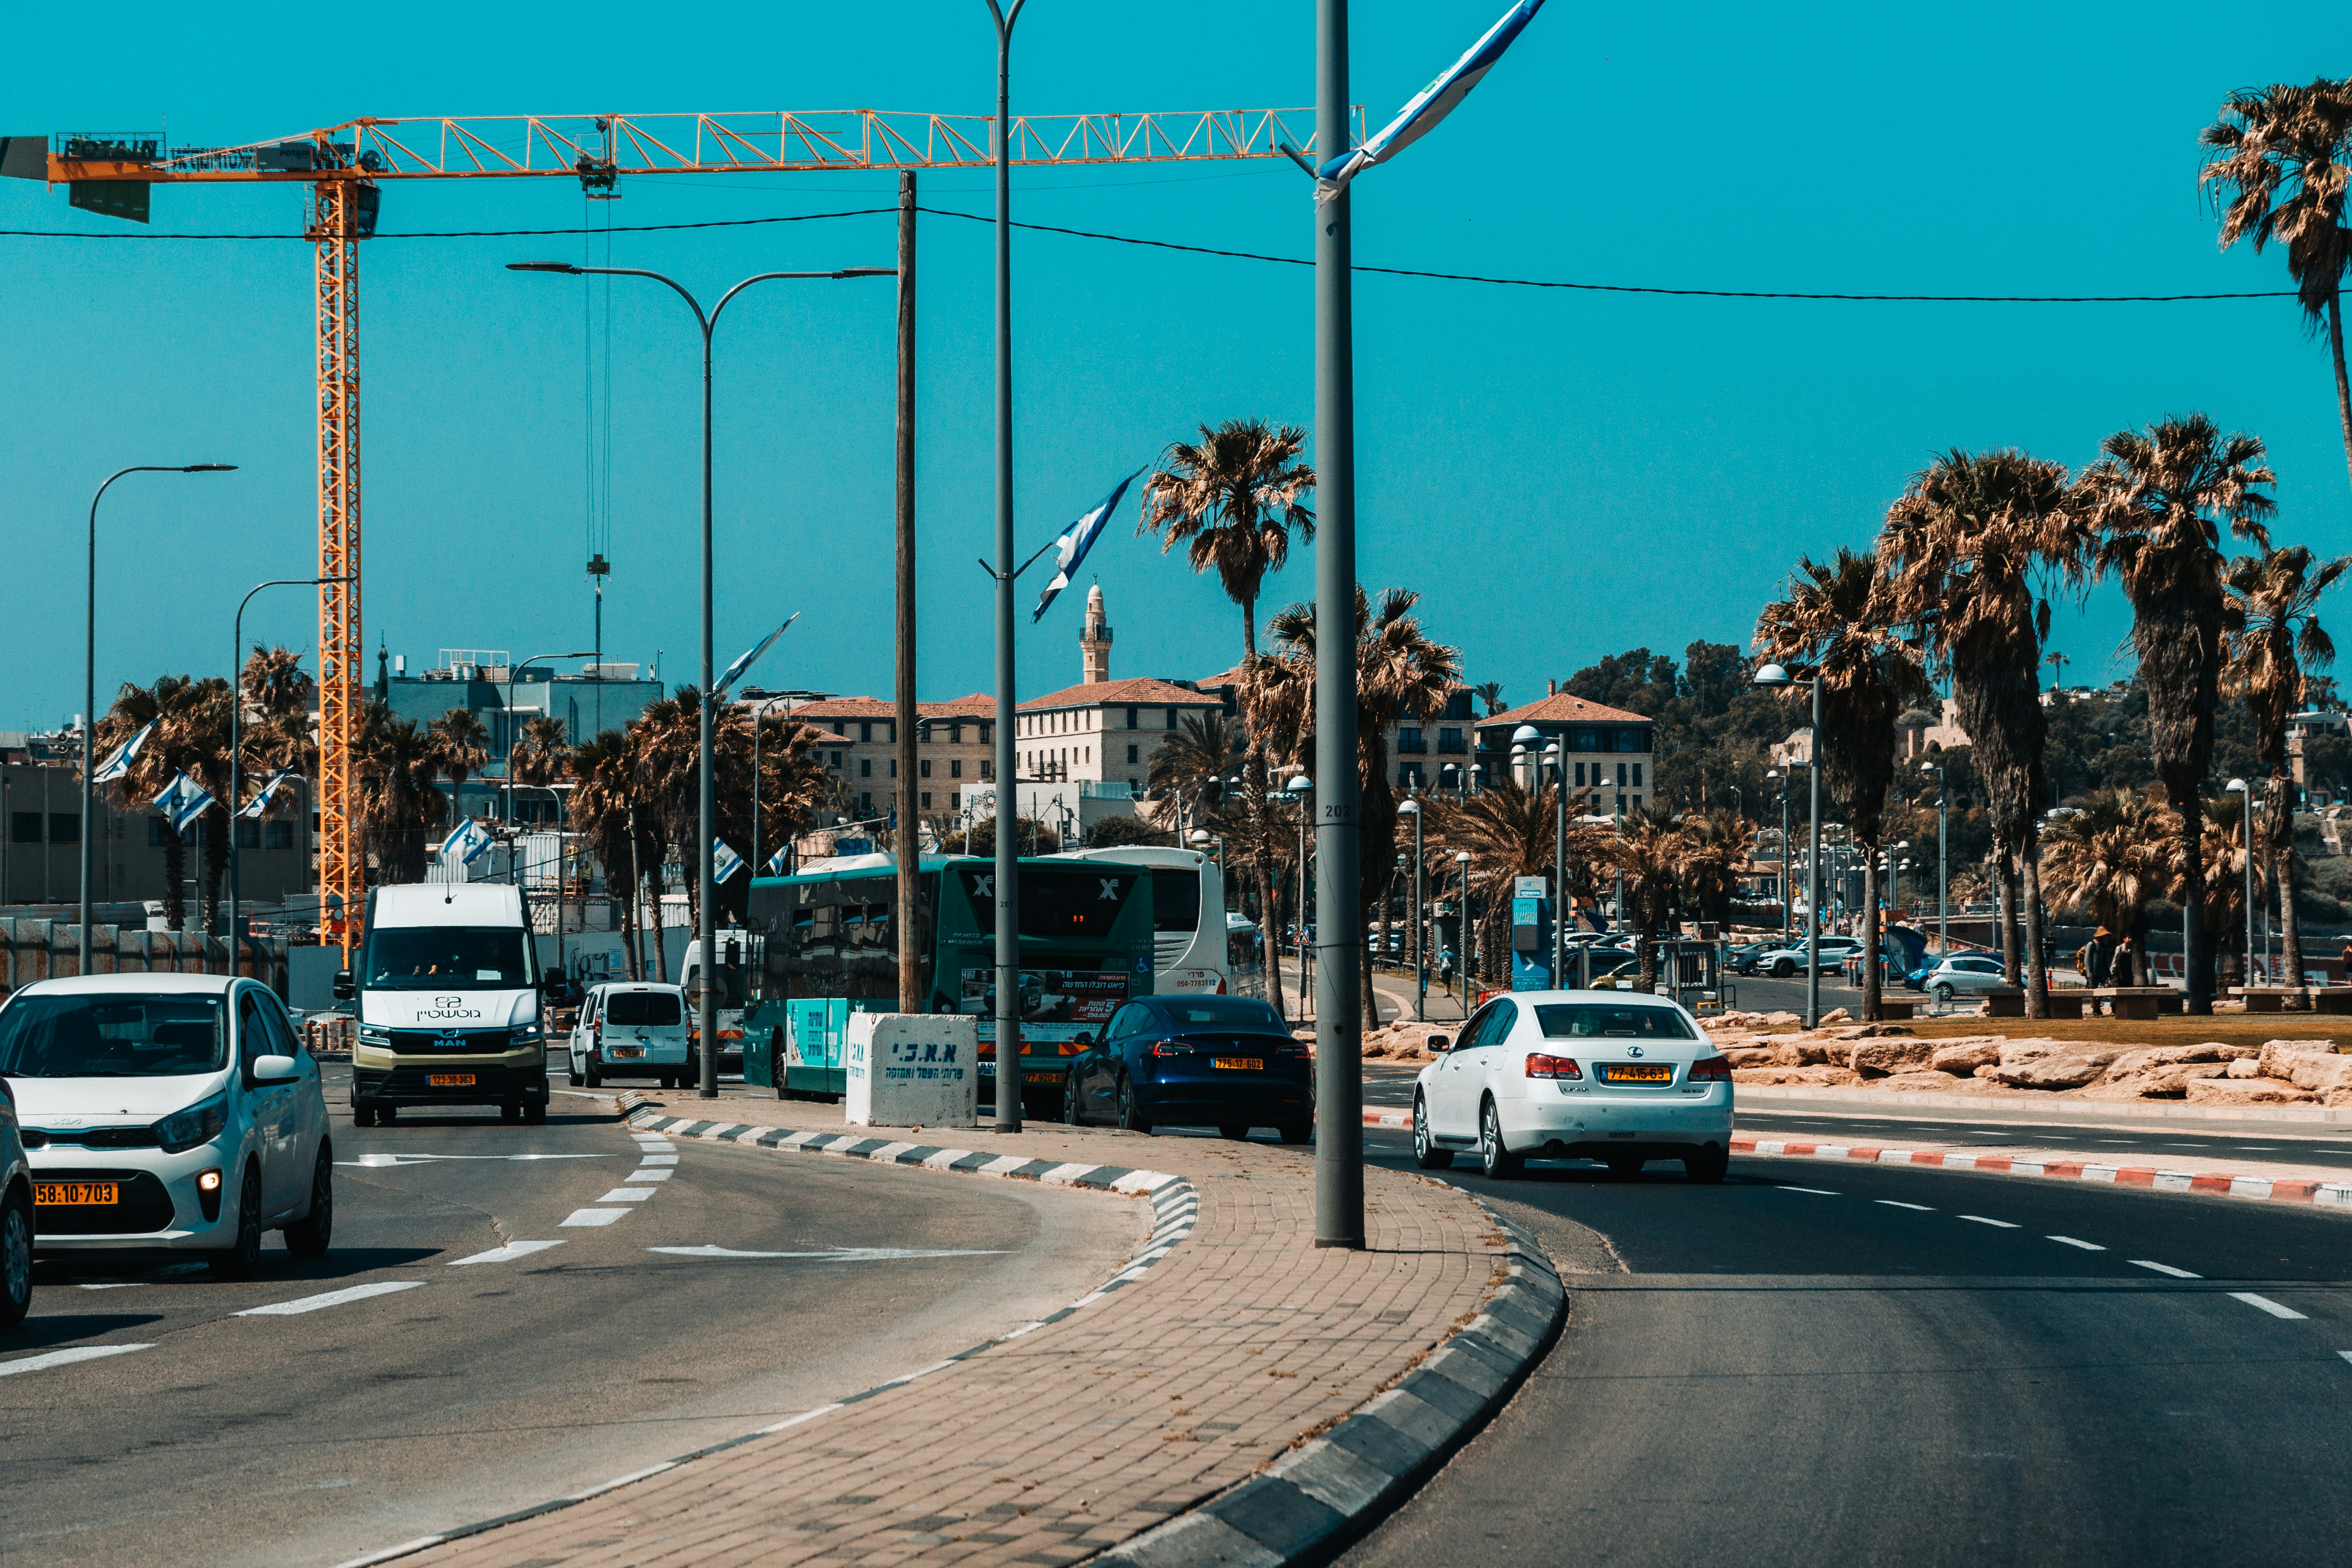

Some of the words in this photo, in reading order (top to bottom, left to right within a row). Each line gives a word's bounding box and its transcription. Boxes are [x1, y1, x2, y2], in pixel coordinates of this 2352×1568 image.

[64, 140, 158, 158] POTAIN
[1325, 805, 1351, 817] 202
[964, 970, 975, 979] FIAT
[1105, 1001, 1115, 1012] 5
[417, 1010, 480, 1021] גוטשטיין
[34, 1184, 112, 1203] 58-10-703
